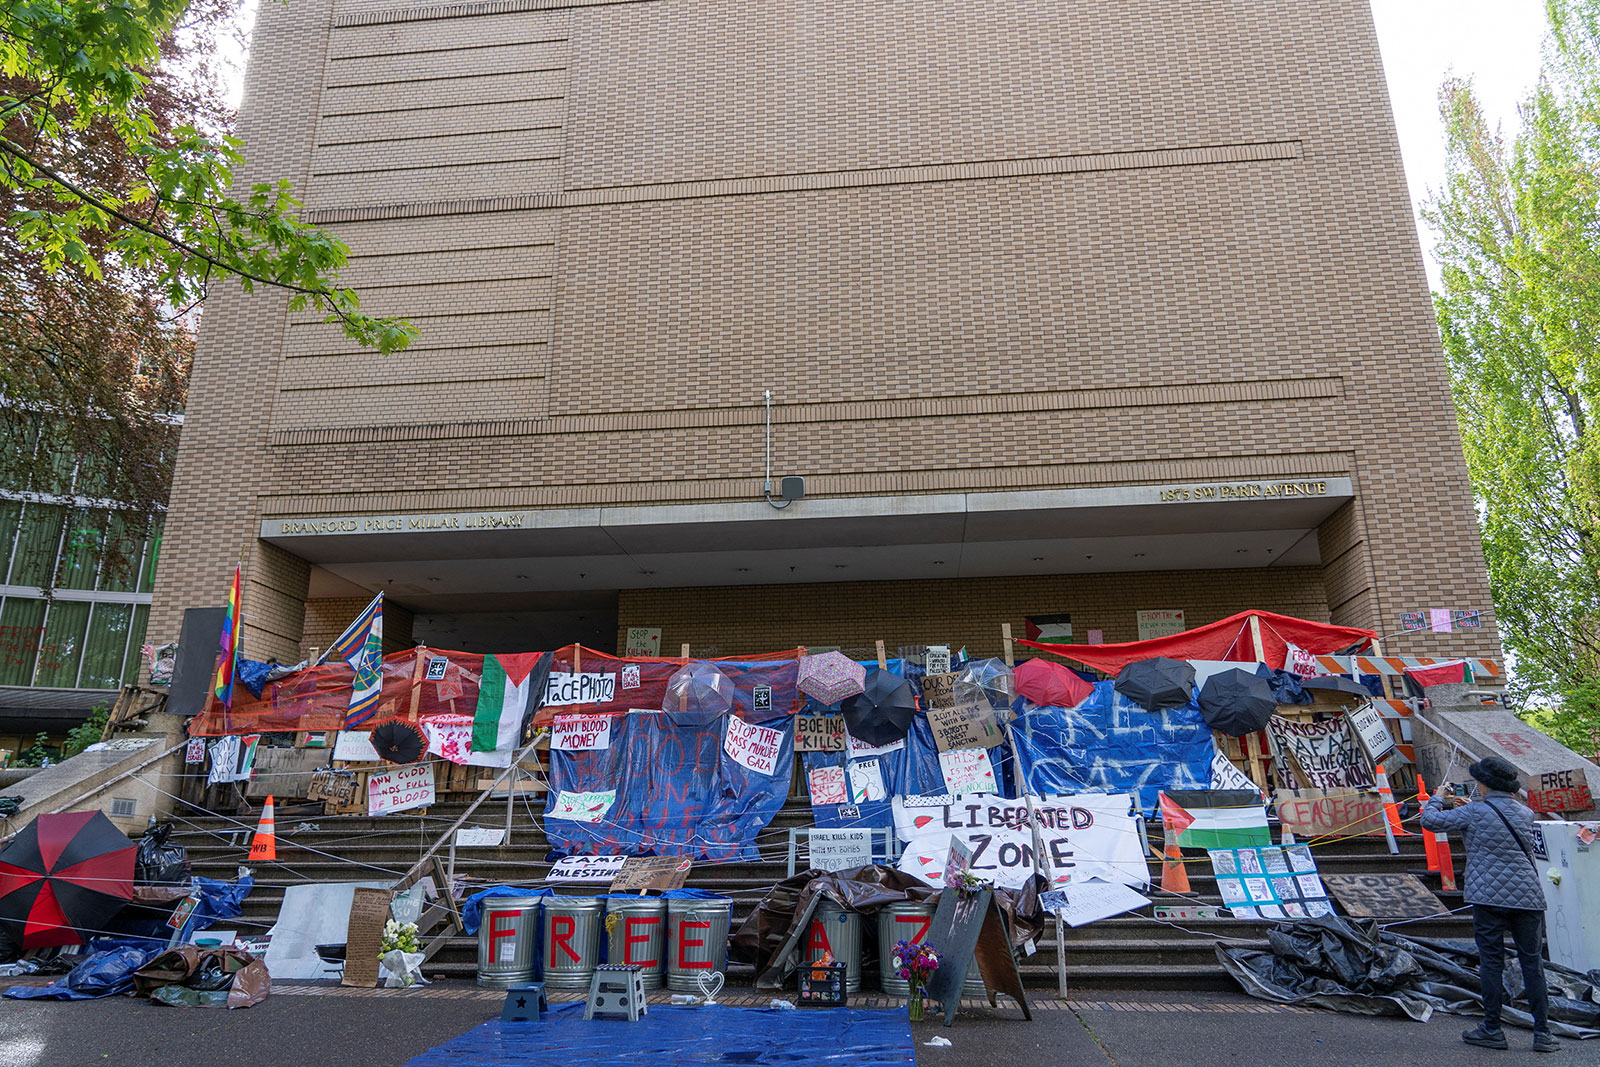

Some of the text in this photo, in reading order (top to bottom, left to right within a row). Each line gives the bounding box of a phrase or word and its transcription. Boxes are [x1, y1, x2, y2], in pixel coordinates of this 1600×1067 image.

[1160, 482, 1327, 501] 1875 SW PARK AVENUE
[282, 514, 525, 534] BRANFORD PRICE MILLAR LIBRARY
[552, 720, 609, 735] WANT BLOOD
[941, 717, 959, 727] WITH
[1356, 711, 1379, 732] SIDEWALK
[560, 732, 600, 749] MONEY
[730, 718, 782, 747] STOP THE
[1368, 730, 1387, 749] CLOSED
[728, 730, 779, 759] MASS MURDER
[803, 735, 842, 749] KILLS
[726, 739, 771, 772] IN GAZA
[942, 751, 976, 765] THIS
[1311, 753, 1337, 772] LIVE
[858, 760, 876, 770] FREE
[964, 763, 980, 773] NOT
[370, 775, 391, 785] ANN
[1345, 763, 1373, 787] NOW
[1541, 770, 1575, 791] FREE
[310, 782, 351, 799] FOREVER
[406, 779, 430, 789] FULL
[953, 781, 996, 794] GENOCIDE
[392, 789, 430, 806] BLOOD
[1527, 785, 1594, 812] PALESTINE
[943, 804, 1094, 831] LIBERATED
[1278, 798, 1384, 829] CEASEFIRE
[811, 832, 865, 842] ISRAEL KILLS KIDS
[560, 856, 635, 865] CAMP
[968, 834, 1077, 870] ZONE
[814, 855, 868, 869] STOP THE
[549, 868, 631, 878] PALESTINE
[1327, 874, 1404, 887] CUDD
